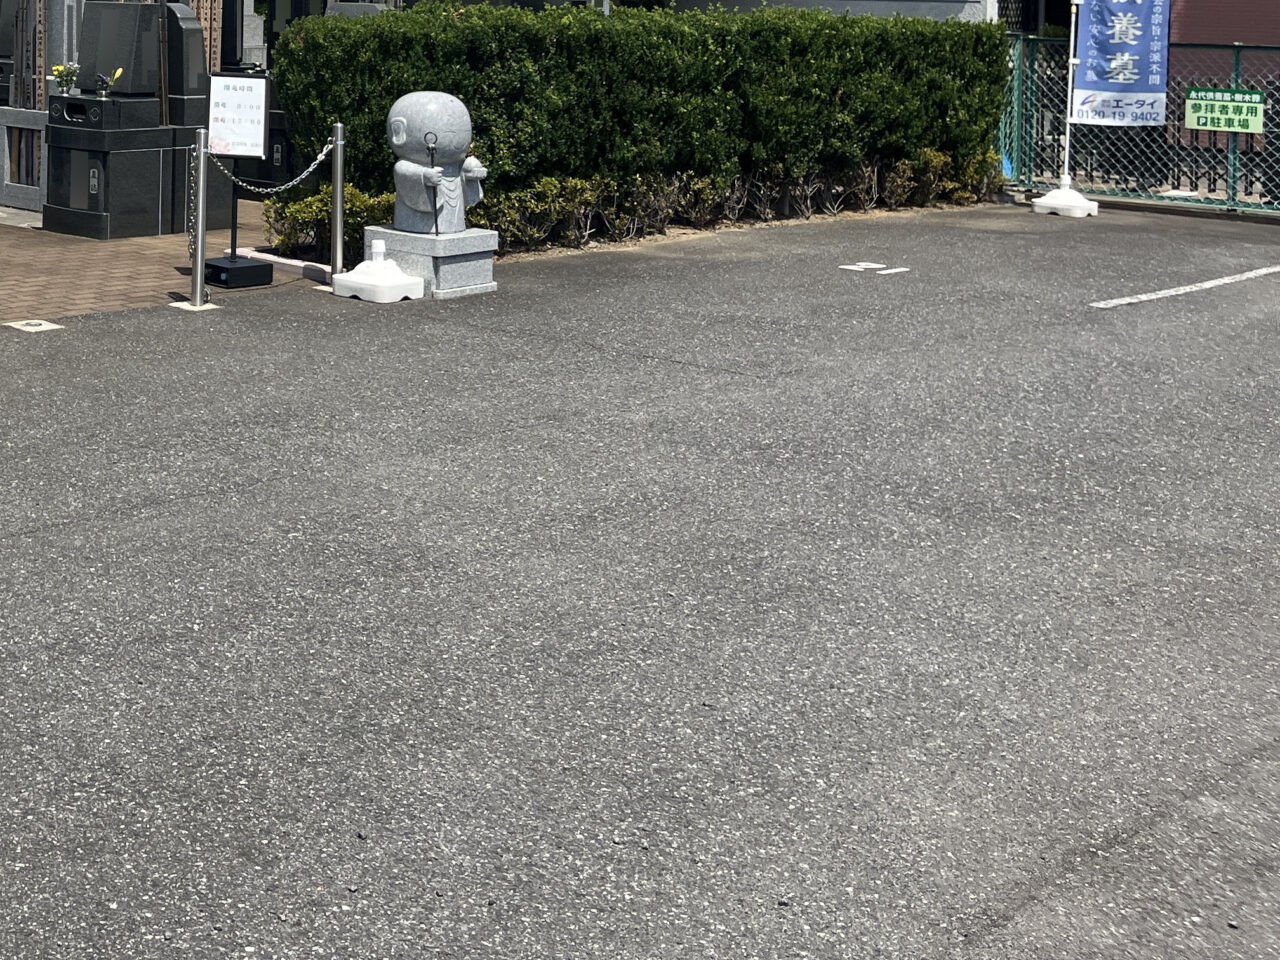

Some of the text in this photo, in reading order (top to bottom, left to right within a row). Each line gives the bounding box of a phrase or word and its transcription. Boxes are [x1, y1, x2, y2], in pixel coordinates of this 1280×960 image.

[1112, 99, 1157, 109] エータイ
[1191, 102, 1258, 117] 参拝者専用
[1209, 117, 1250, 130] 駐車場
